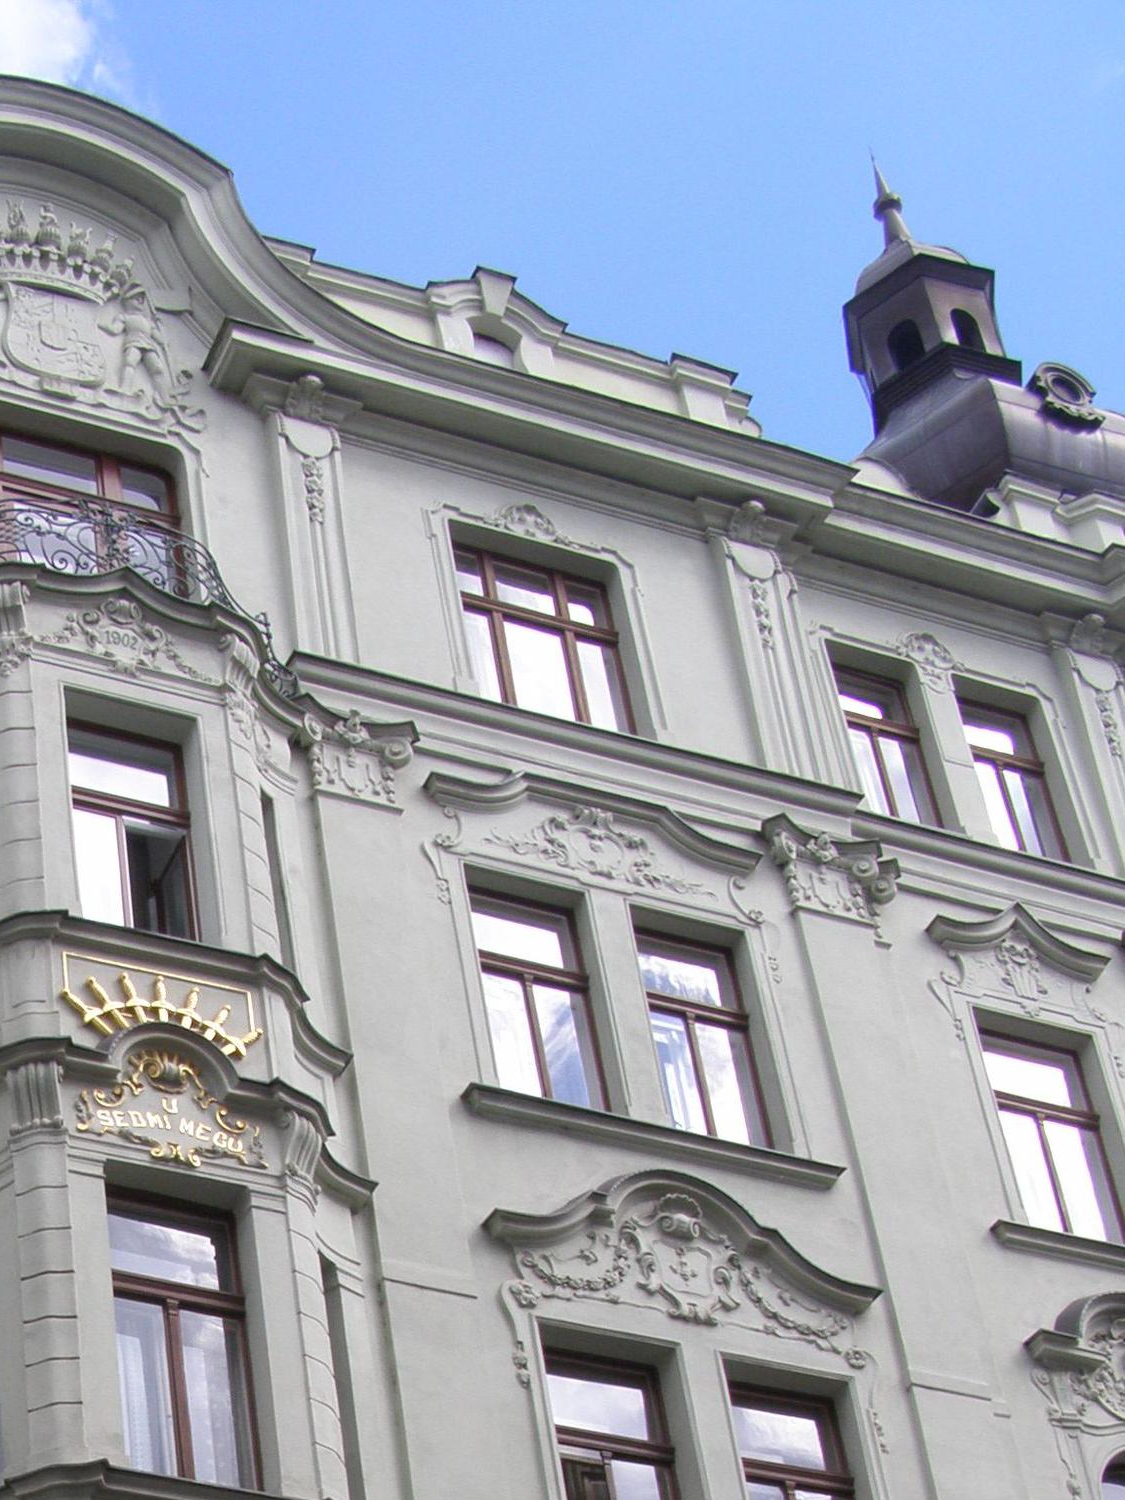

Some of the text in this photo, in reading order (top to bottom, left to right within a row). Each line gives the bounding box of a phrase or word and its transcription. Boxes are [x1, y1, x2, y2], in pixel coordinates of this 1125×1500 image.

[105, 630, 138, 650] 1902
[162, 1098, 179, 1114] U
[96, 1109, 172, 1130] SEDMI
